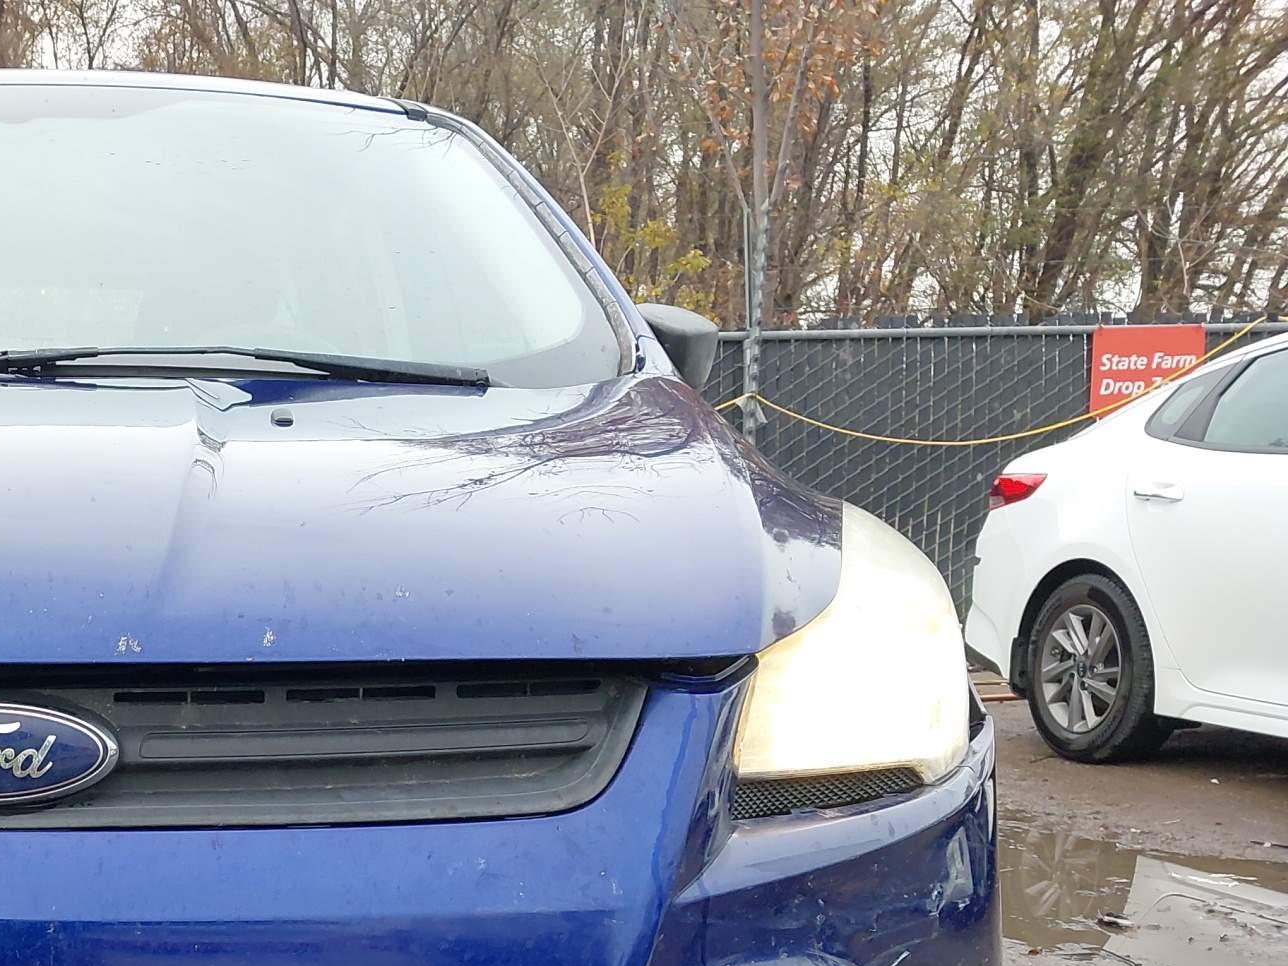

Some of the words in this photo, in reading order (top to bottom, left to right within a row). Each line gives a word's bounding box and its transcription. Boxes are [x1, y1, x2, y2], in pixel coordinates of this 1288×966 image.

[1099, 353, 1148, 371] State
[1151, 352, 1197, 369] Farm
[1099, 378, 1145, 397] Drop
